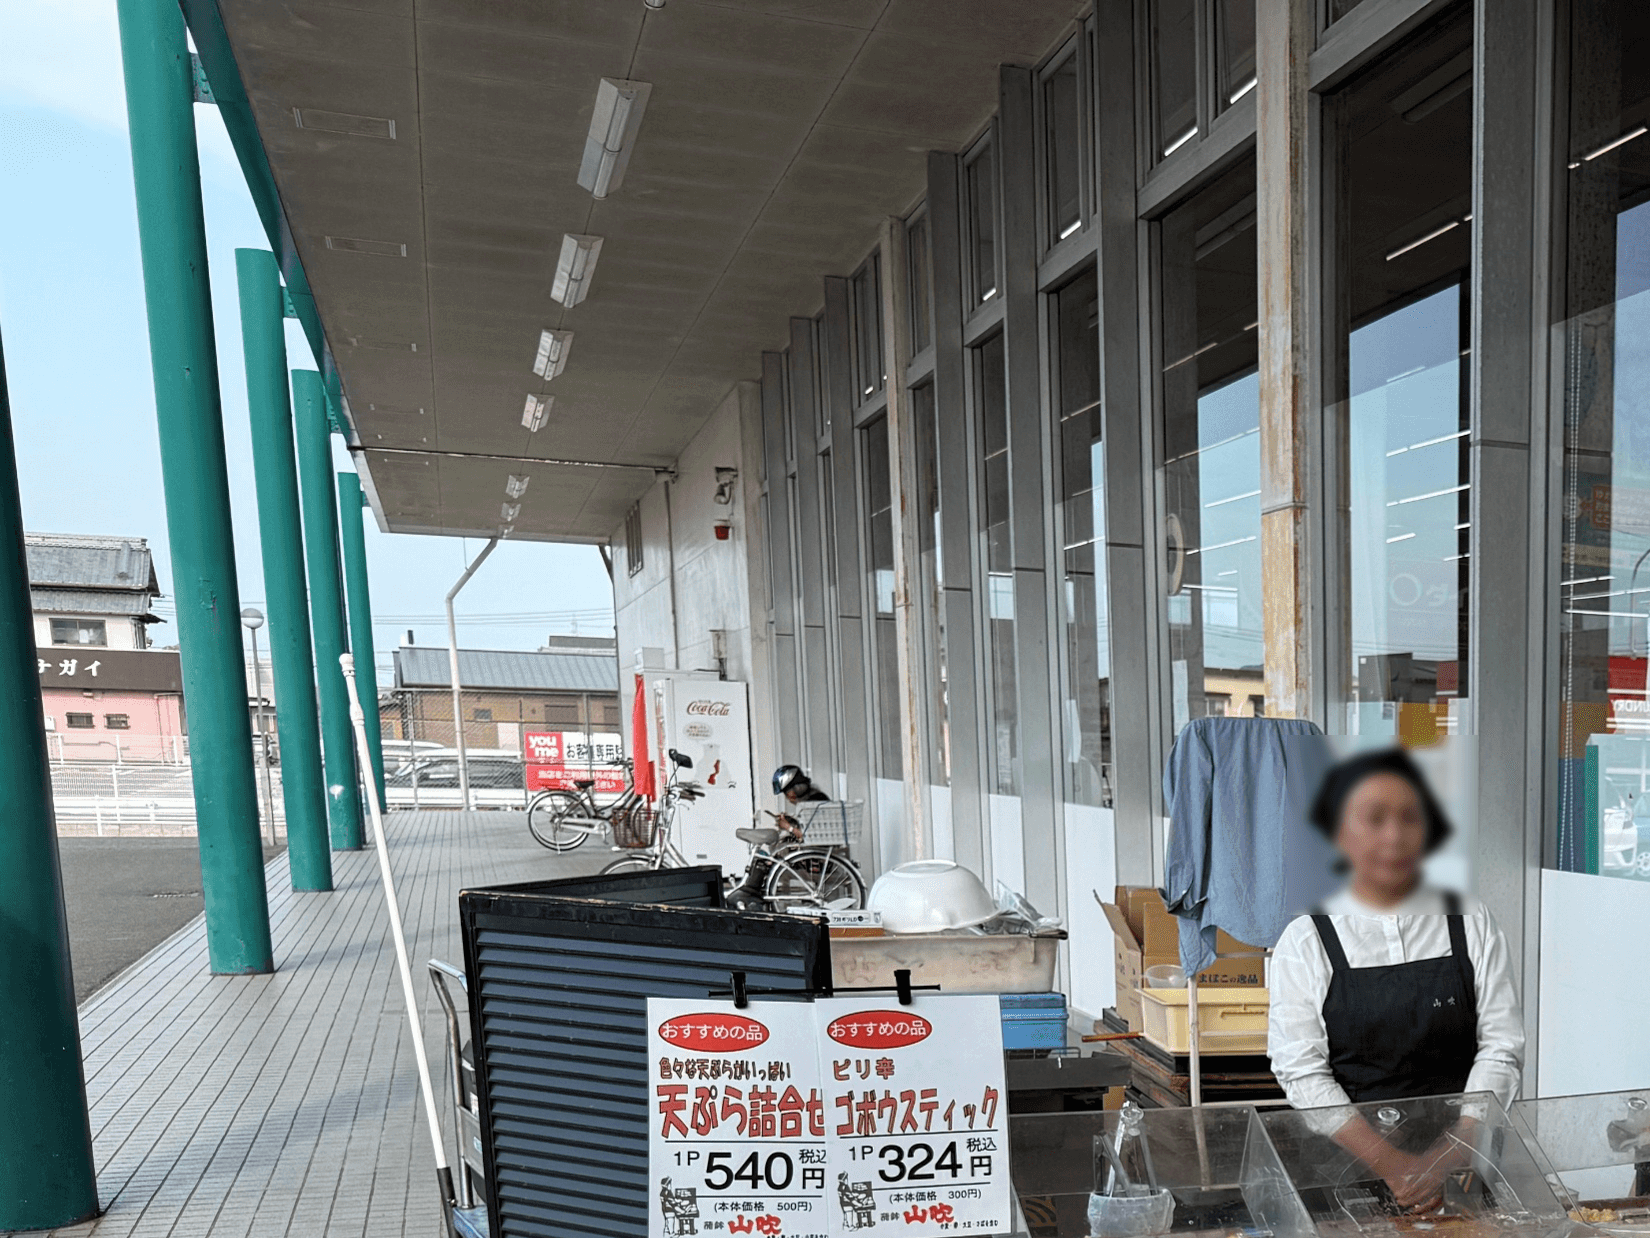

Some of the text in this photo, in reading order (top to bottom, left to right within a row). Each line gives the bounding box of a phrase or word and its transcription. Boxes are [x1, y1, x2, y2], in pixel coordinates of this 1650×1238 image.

[528, 735, 557, 749] you
[534, 747, 560, 758] me
[661, 1022, 763, 1041] おすすめの品
[830, 1020, 927, 1038] おすすめの品
[659, 1056, 792, 1082] 色々な天ぷらがいっぱい
[833, 1057, 895, 1081] ピリ辛
[656, 1084, 826, 1139] 天ぷら詰合せ
[835, 1085, 999, 1137] ゴボウスティック
[674, 1150, 701, 1167] 1P
[704, 1151, 794, 1190] 540
[802, 1167, 825, 1190] 円
[848, 1136, 998, 1183] 1P 324 税込 円
[948, 1188, 982, 1200] 300円)
[713, 1201, 813, 1213] (本体価格 500円)
[903, 1202, 955, 1225] 山吹
[727, 1213, 783, 1236] 山吹
